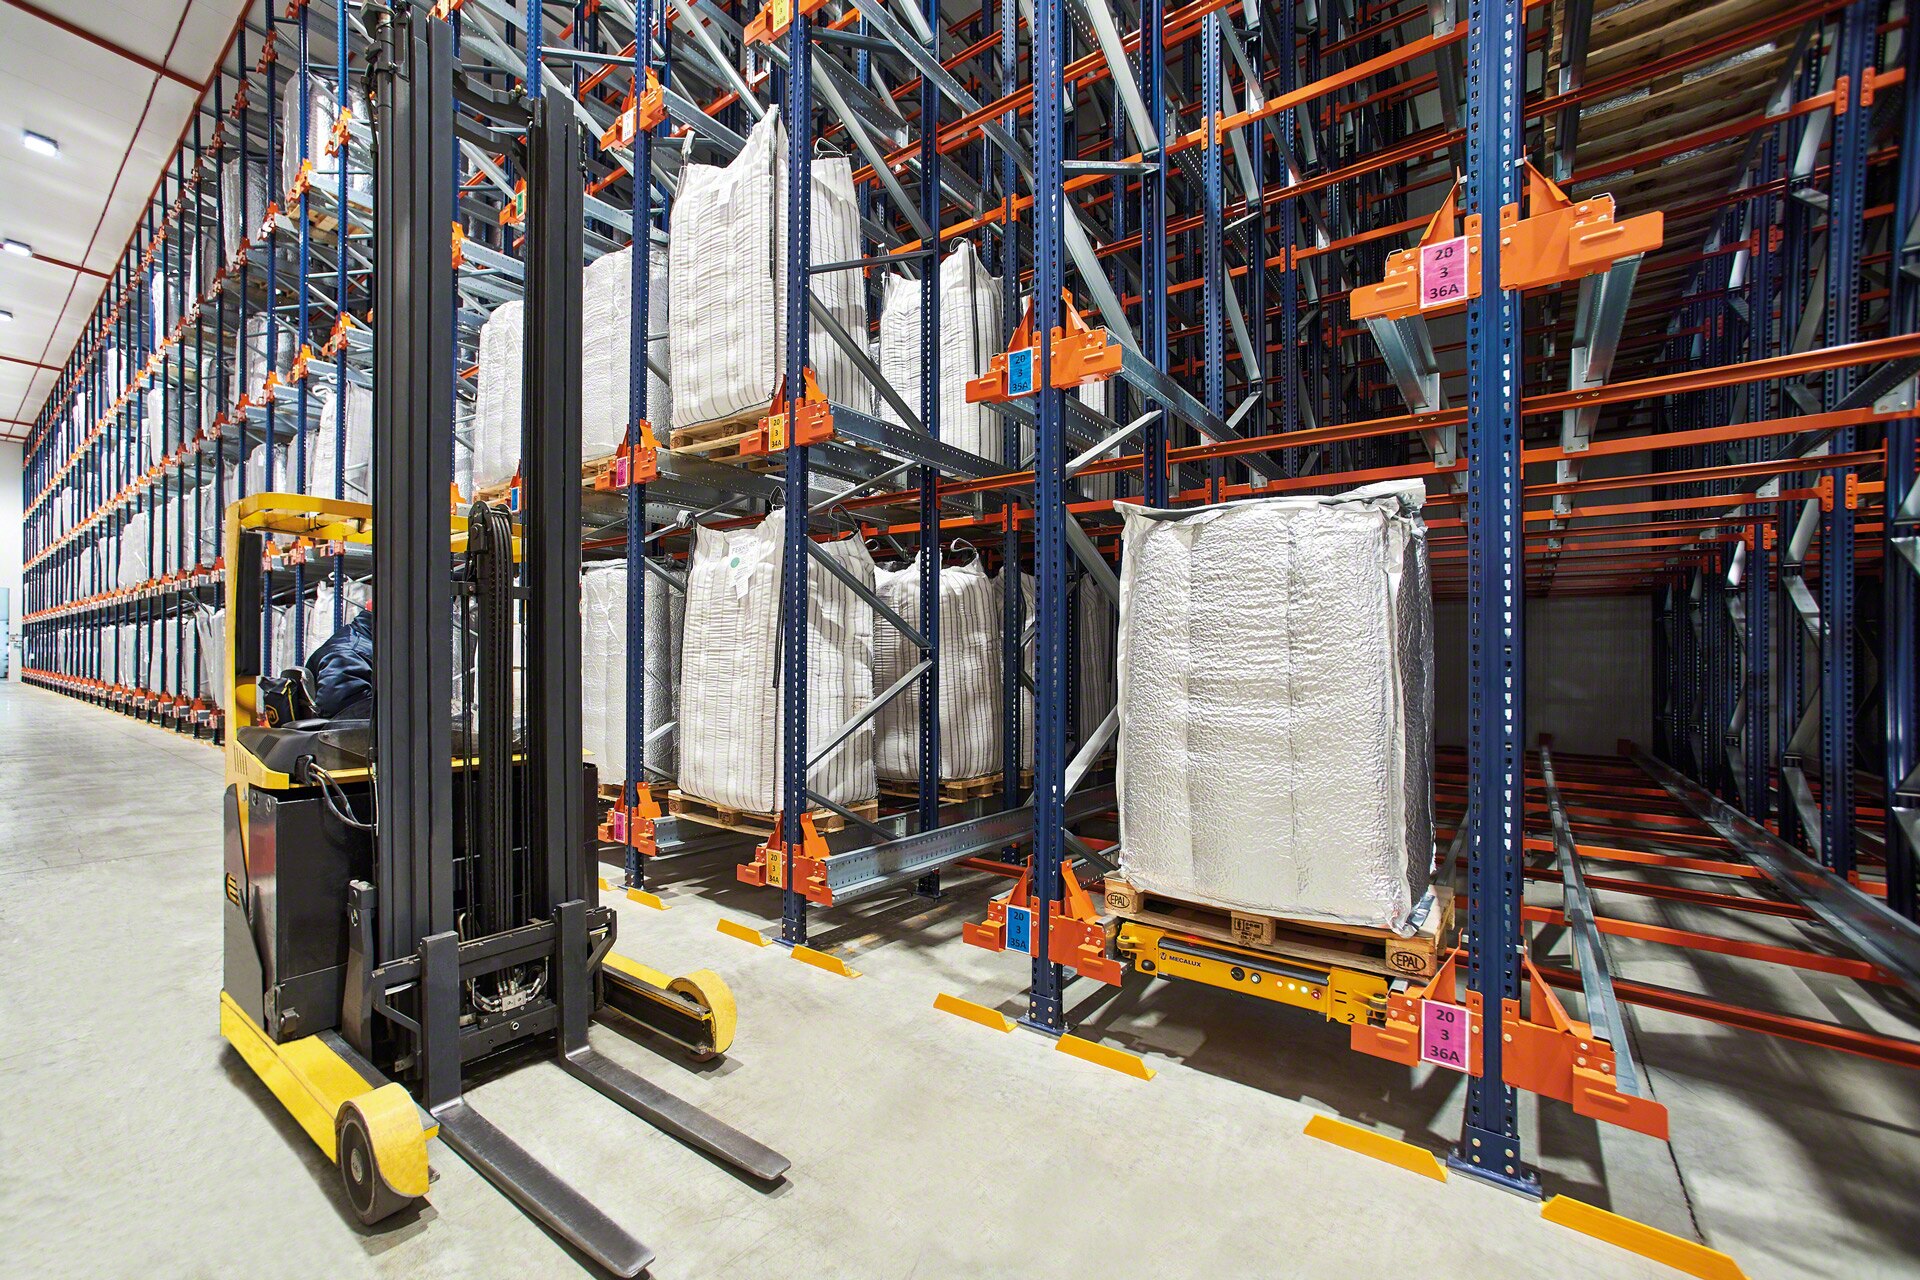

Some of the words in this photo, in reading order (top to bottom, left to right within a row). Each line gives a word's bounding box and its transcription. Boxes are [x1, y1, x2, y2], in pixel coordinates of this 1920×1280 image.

[1435, 247, 1453, 260] 20
[1440, 267, 1448, 278] 3
[1430, 284, 1459, 299] 36A
[1015, 355, 1026, 364] 20
[1012, 381, 1028, 391] 35A
[772, 440, 782, 448] 34A
[769, 875, 780, 884] 34A
[1014, 912, 1024, 921] 20
[1016, 926, 1021, 934] 3
[1010, 938, 1027, 949] 35A
[1169, 955, 1202, 968] MECALUX
[1347, 1013, 1356, 1023] 2
[1436, 1009, 1455, 1023] 20
[1440, 1029, 1450, 1041] 3
[1430, 1045, 1460, 1063] 36A
